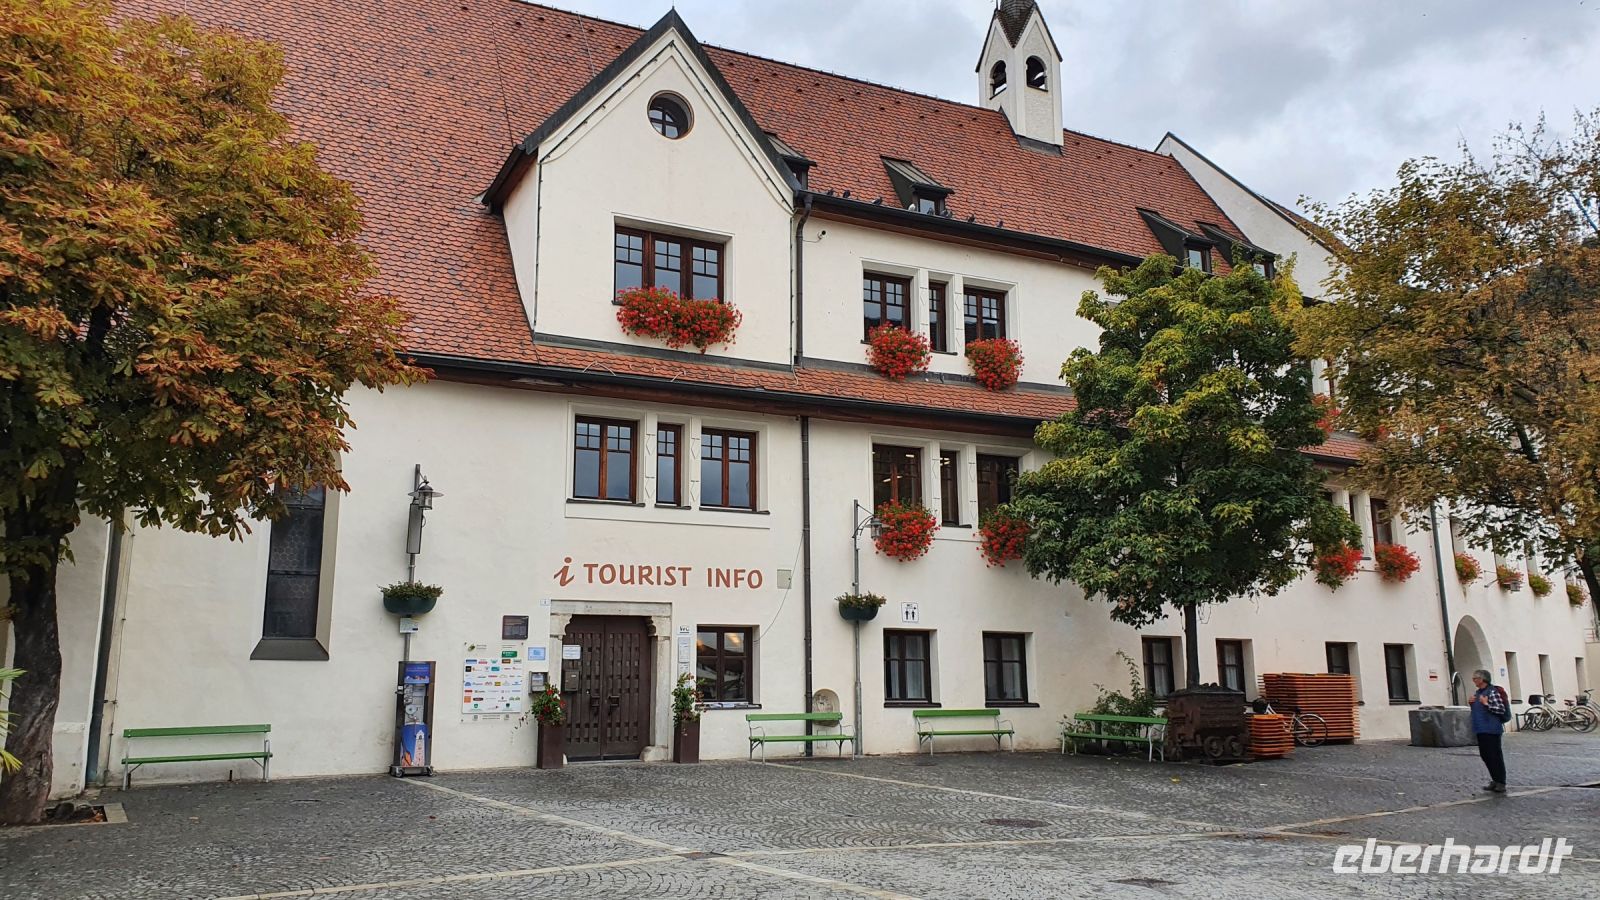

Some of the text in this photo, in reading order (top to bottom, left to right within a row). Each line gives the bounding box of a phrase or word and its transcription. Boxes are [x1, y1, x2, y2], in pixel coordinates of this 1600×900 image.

[553, 556, 763, 589] i TOURIST INFO
